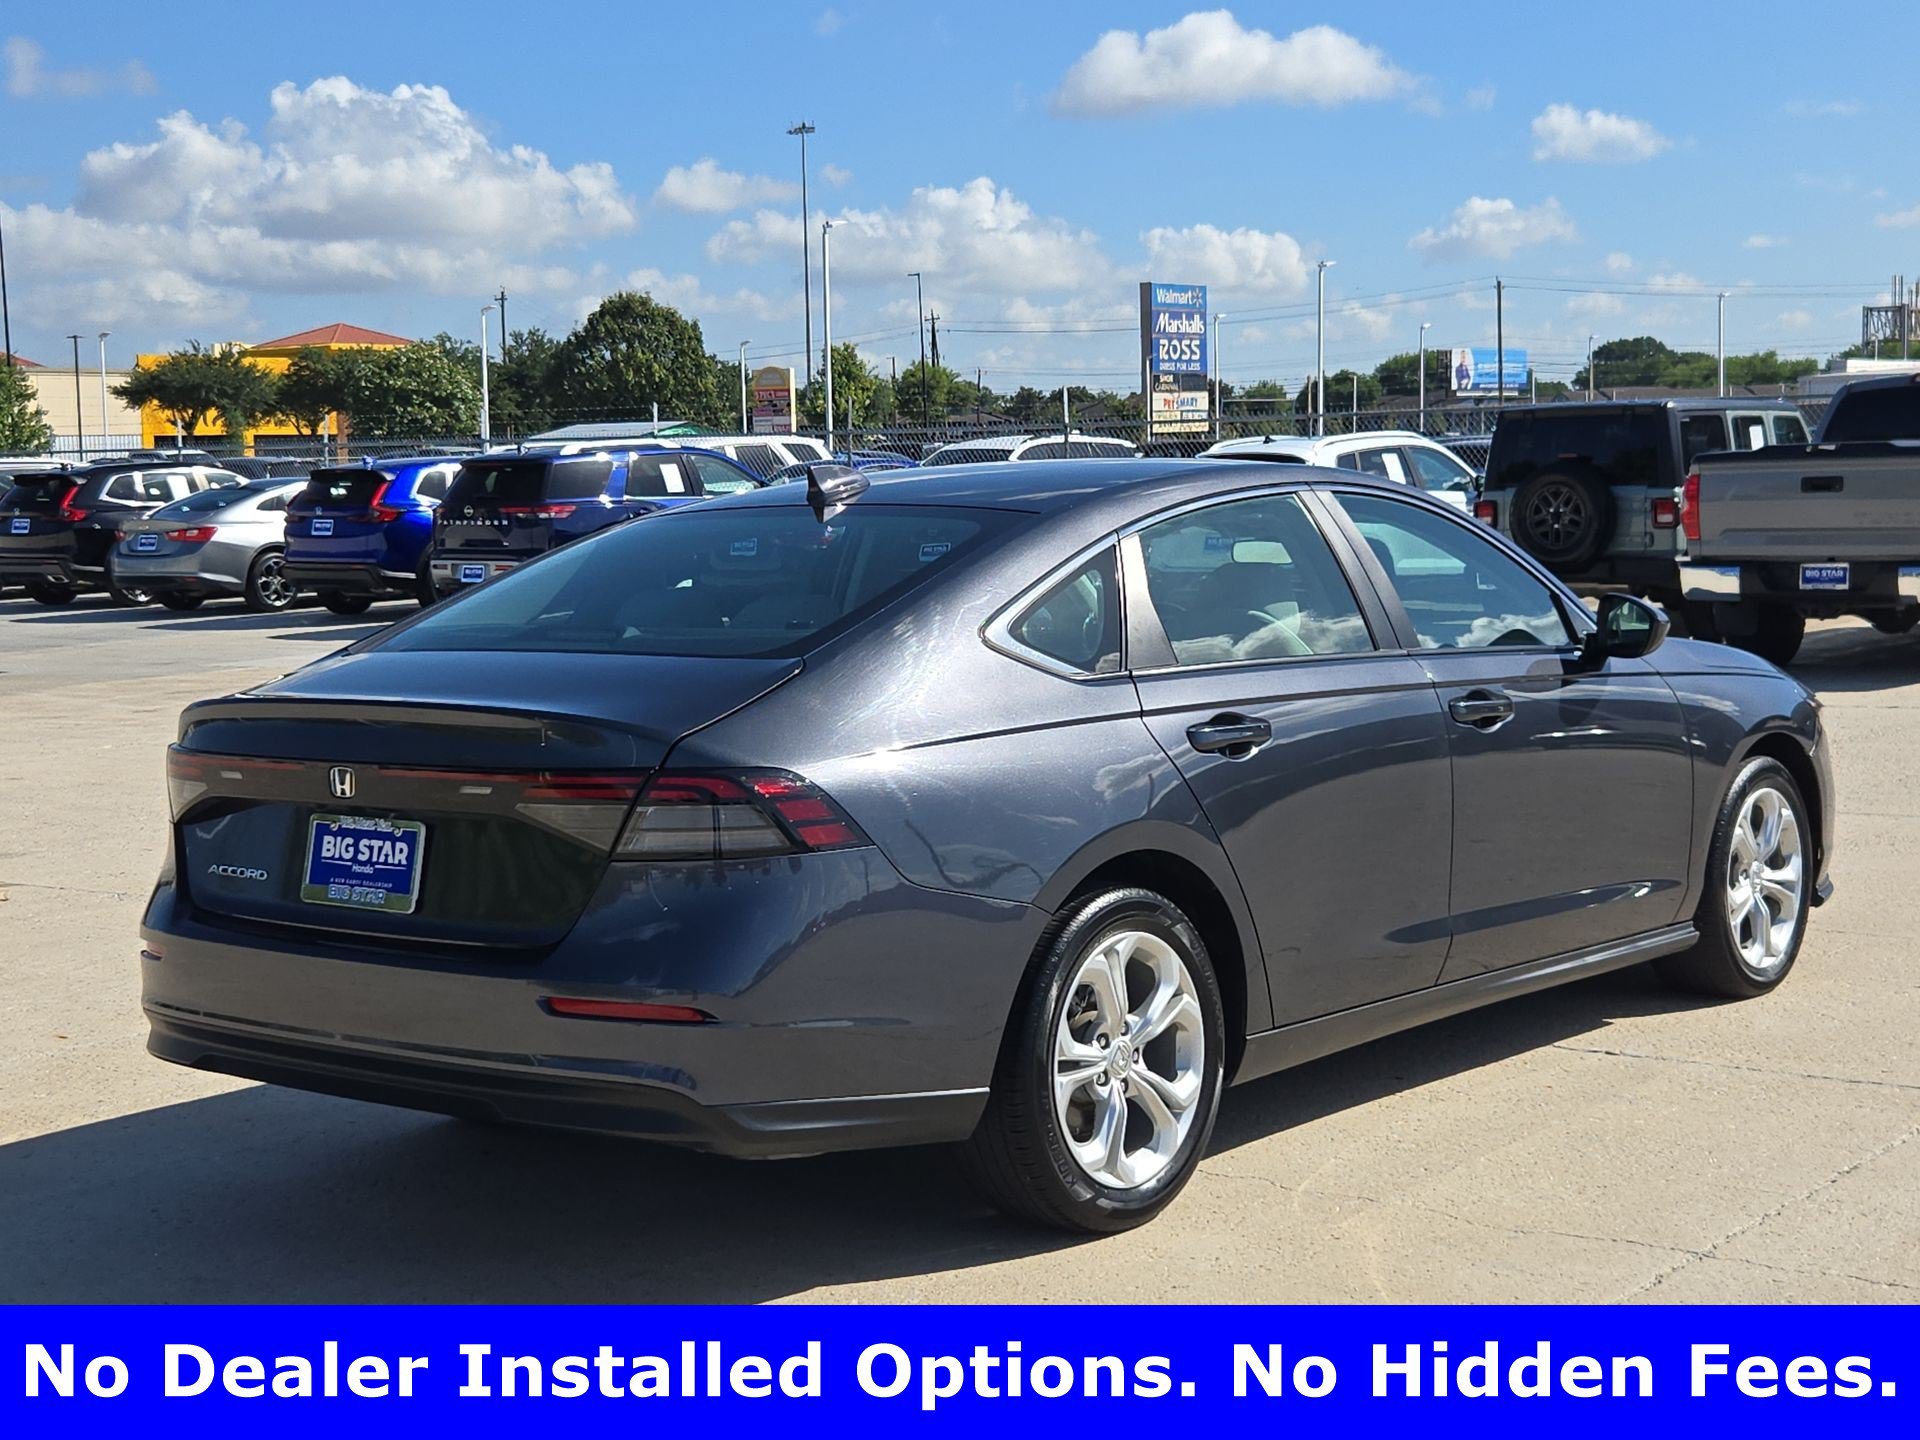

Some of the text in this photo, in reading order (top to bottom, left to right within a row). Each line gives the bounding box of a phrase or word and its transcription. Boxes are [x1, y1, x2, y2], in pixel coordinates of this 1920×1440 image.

[1156, 288, 1193, 305] Walmart
[1155, 312, 1205, 334] Marshalls
[1159, 339, 1201, 360] ROSS
[321, 835, 409, 865] BIG STAR
[207, 864, 269, 881] ACCORD
[351, 863, 375, 874] Honda
[328, 884, 385, 904] BIG STAR
